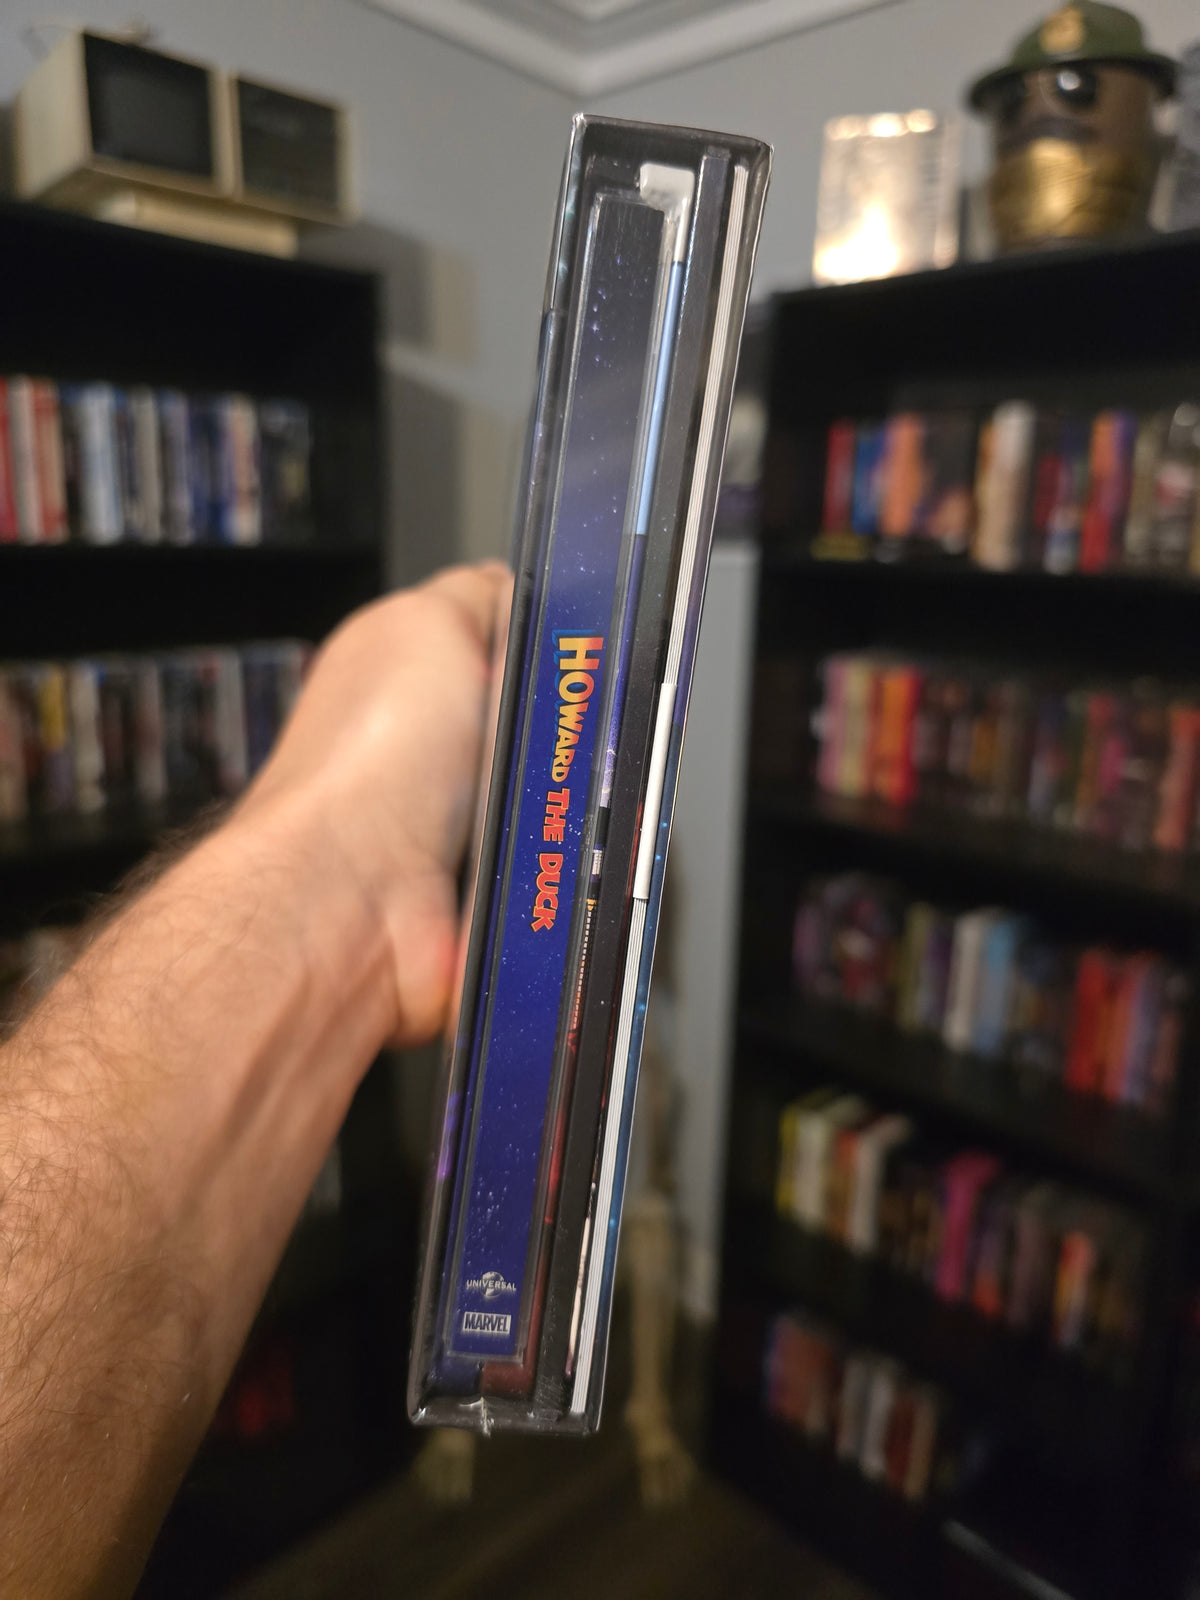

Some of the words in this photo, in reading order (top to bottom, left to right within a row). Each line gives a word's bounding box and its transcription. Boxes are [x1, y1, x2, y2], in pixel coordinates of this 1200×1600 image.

[551, 632, 604, 783] HOWARD
[544, 788, 570, 842] THE
[531, 852, 564, 932] DUCK
[466, 1279, 517, 1291] UNIVERSAL
[463, 1312, 510, 1333] MARVEL
